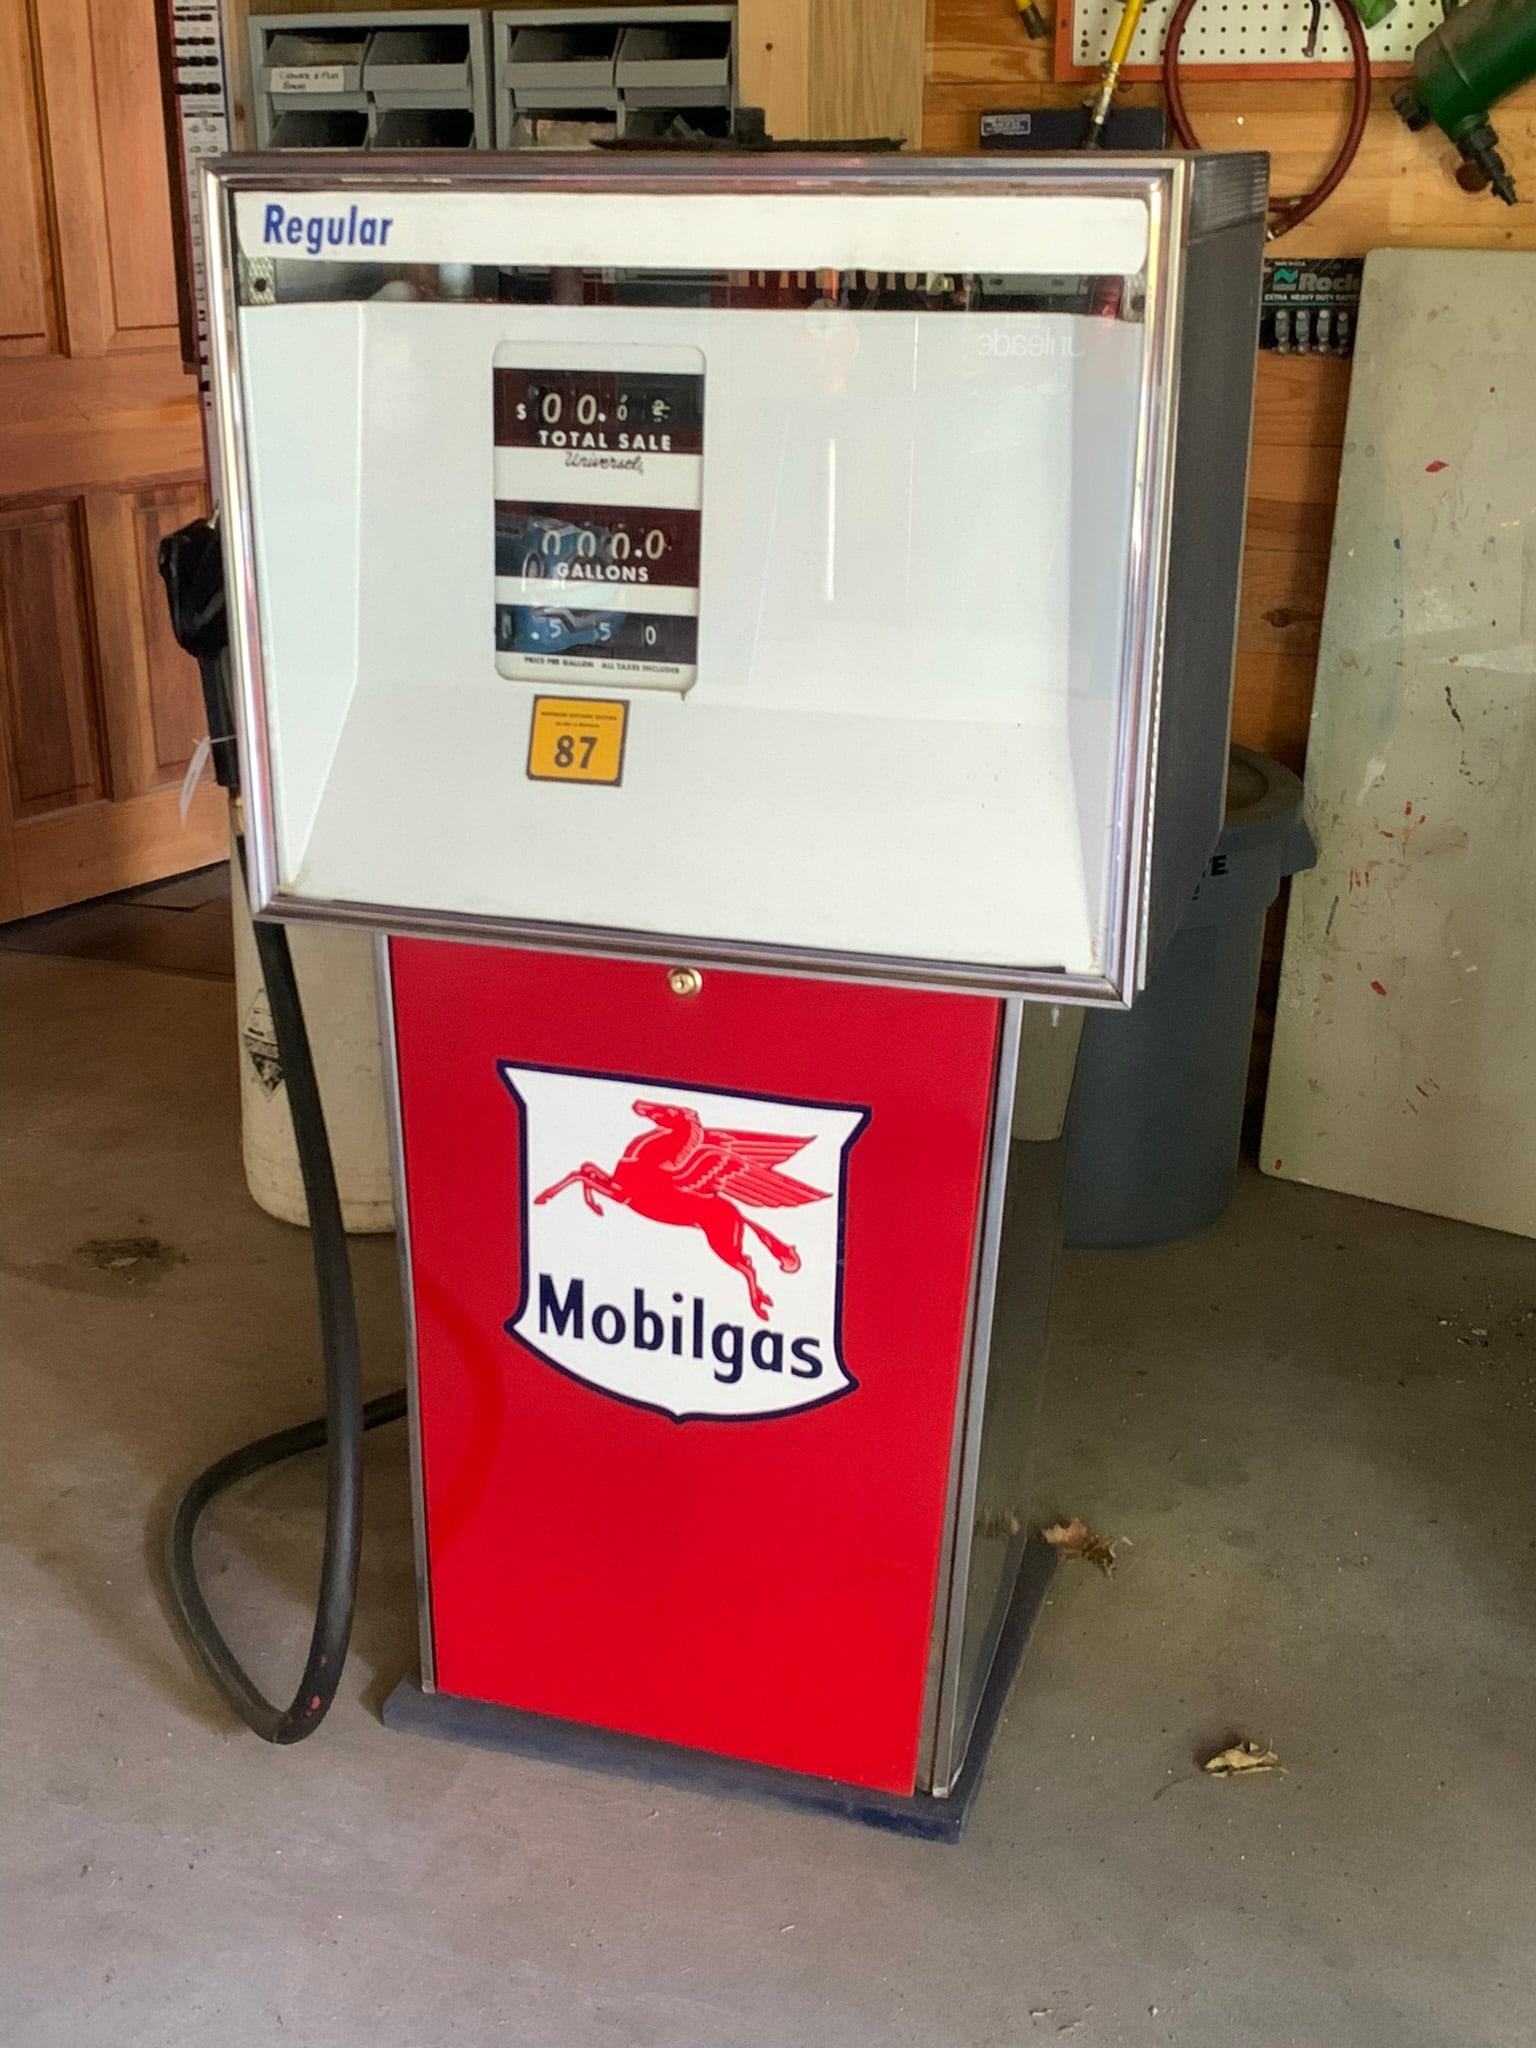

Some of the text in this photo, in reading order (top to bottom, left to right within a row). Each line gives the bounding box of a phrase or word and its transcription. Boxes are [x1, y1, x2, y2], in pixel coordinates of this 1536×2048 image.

[263, 203, 394, 255] Regular
[538, 429, 671, 452] TOTAL SALE
[556, 561, 649, 583] GALLONS
[553, 734, 599, 770] 87
[537, 1272, 824, 1384] Mobilgas
